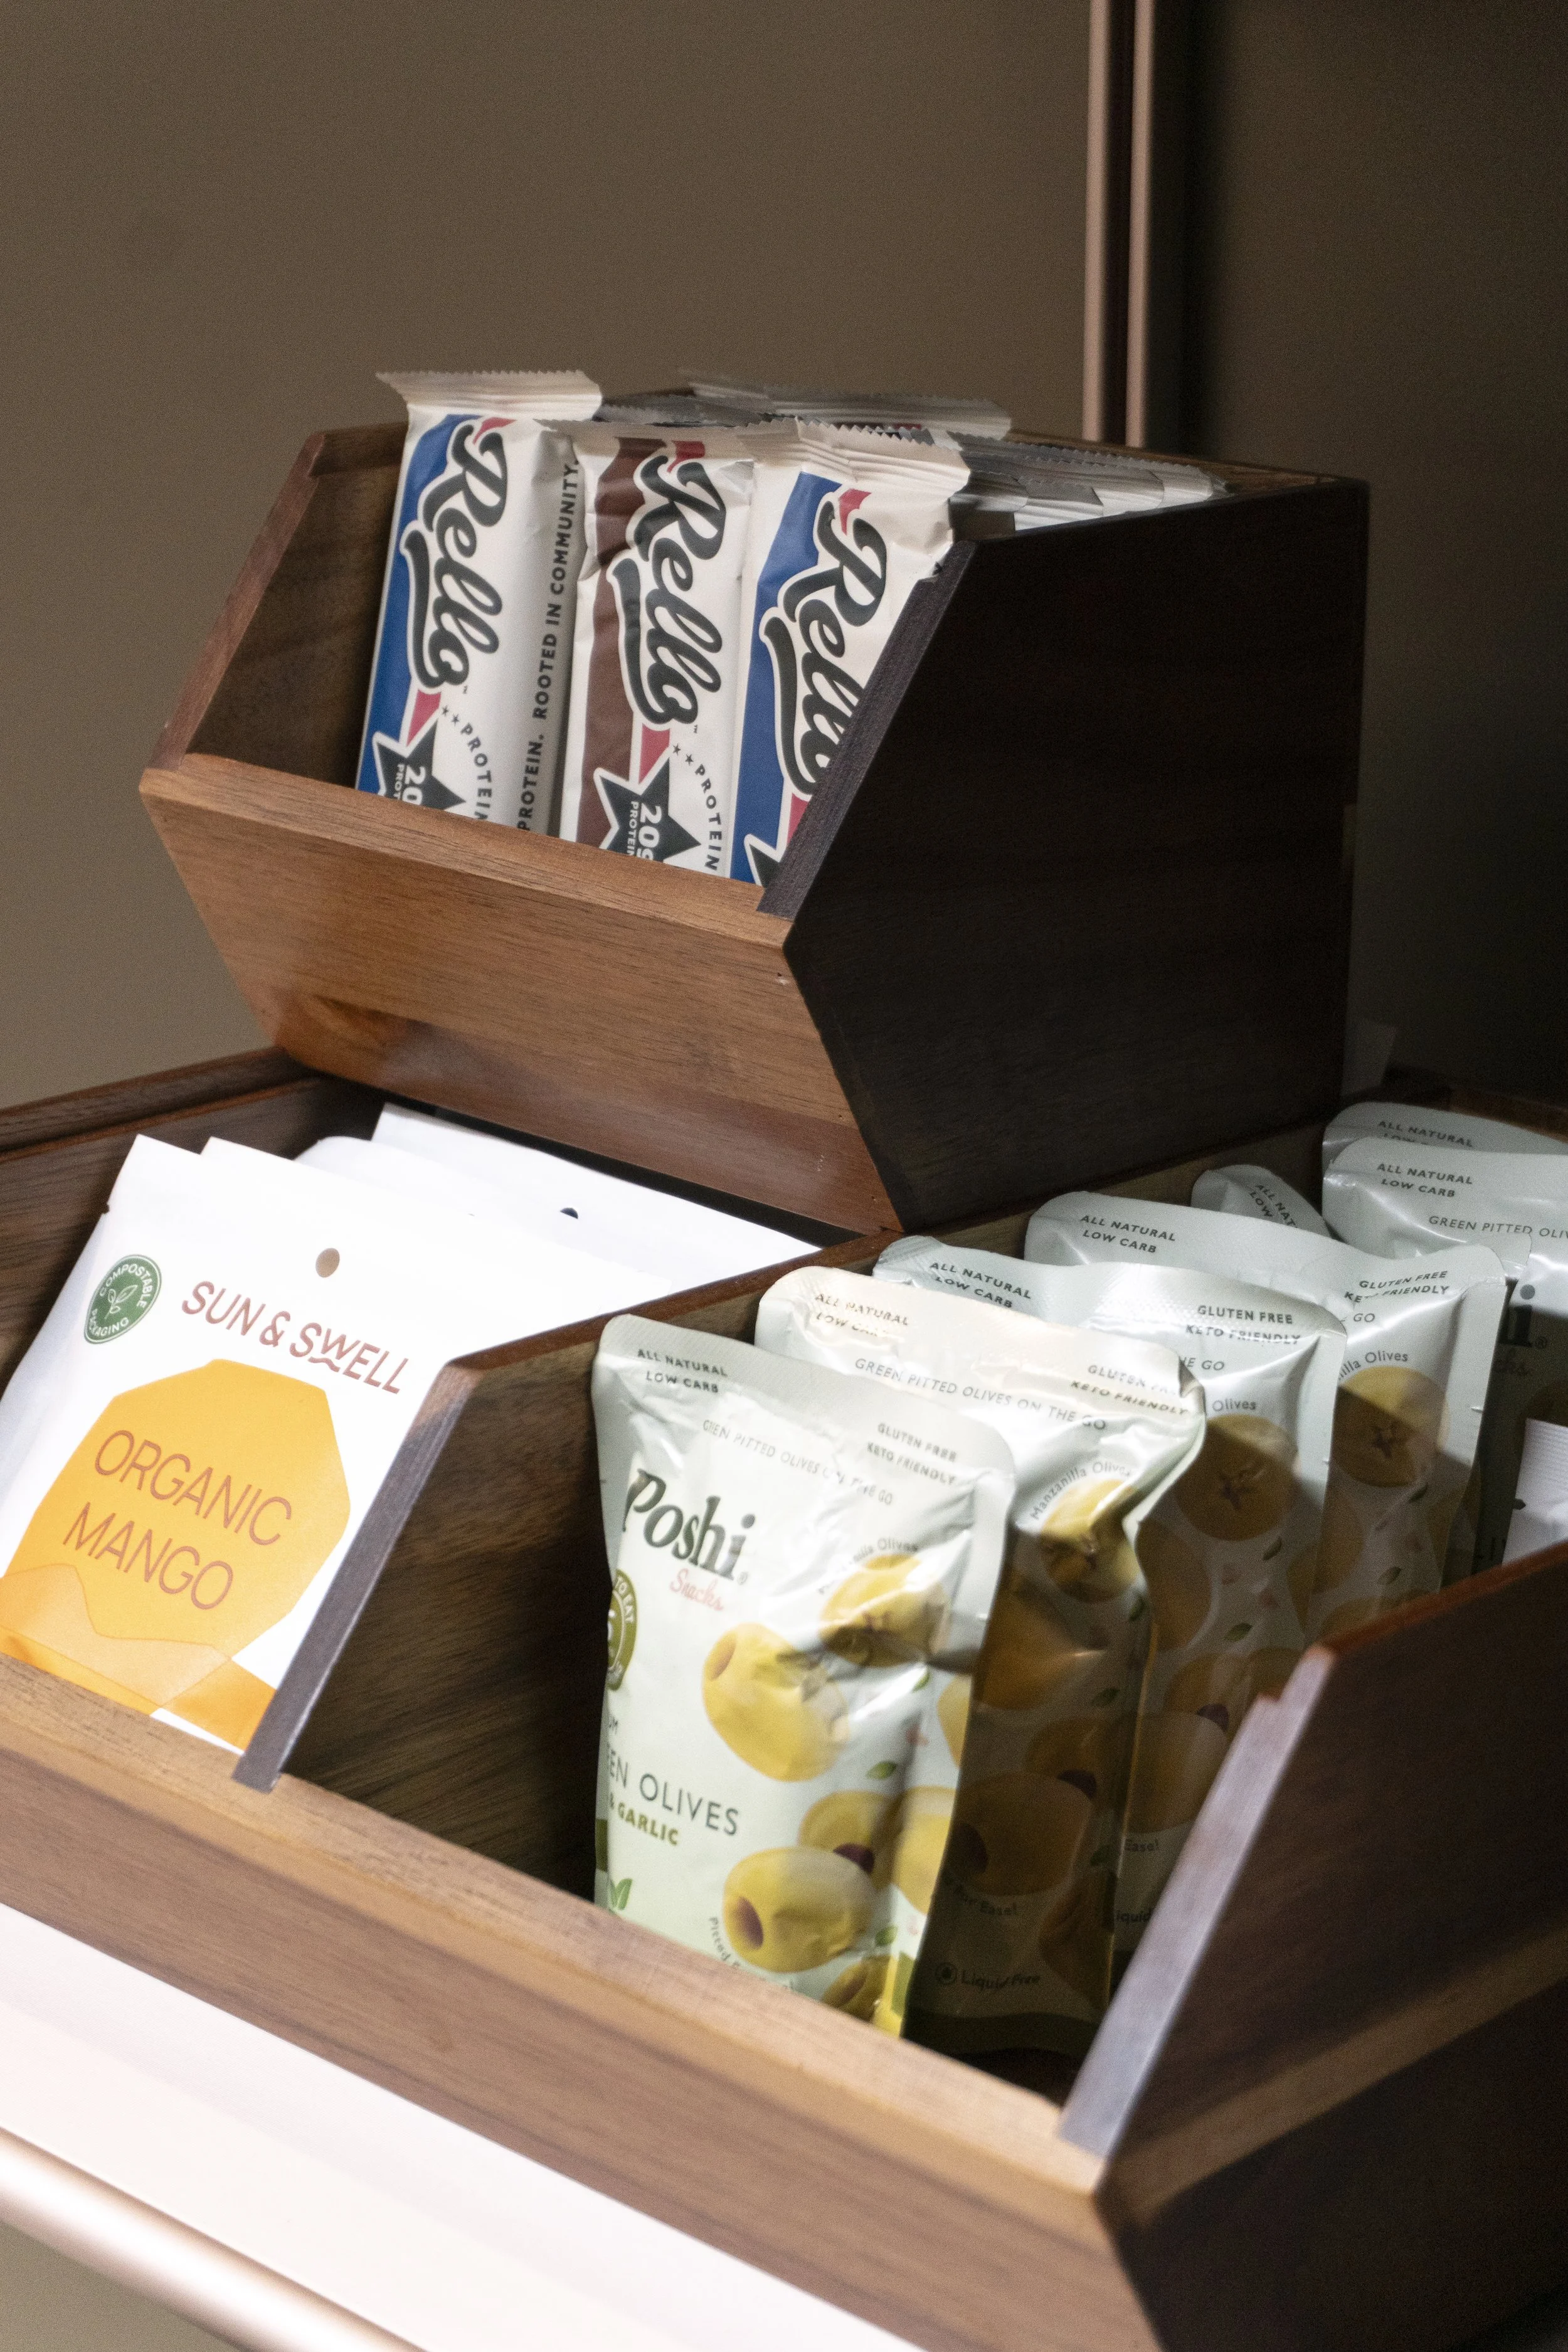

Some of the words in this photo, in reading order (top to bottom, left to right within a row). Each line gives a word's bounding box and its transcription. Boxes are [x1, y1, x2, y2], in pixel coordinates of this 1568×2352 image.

[550, 459, 580, 595] COMMUNITY.
[405, 424, 507, 688] Rello
[612, 455, 727, 725] Rello
[546, 603, 563, 627] IN
[532, 633, 557, 720] ROOTED
[694, 763, 723, 871] PROTEIN
[1379, 1121, 1402, 1131] ALL
[1408, 1127, 1473, 1148] NATURAL
[1377, 1163, 1402, 1175] ALL
[1407, 1168, 1473, 1185] NATURAL
[1382, 1179, 1414, 1190] LOW
[1418, 1185, 1455, 1197] CARB
[1249, 1191, 1273, 1219] LOW
[1255, 1184, 1276, 1200] ALL
[1079, 1215, 1105, 1226] ALL
[1110, 1221, 1176, 1241] NATURAL
[1429, 1216, 1477, 1231] GREEN
[1481, 1222, 1533, 1234] PITTED
[1083, 1229, 1116, 1243] LOW
[1120, 1238, 1157, 1253] CARB
[100, 1263, 153, 1308] COMPOSTABLE
[930, 1262, 956, 1273] ALL
[962, 1268, 1032, 1300] NATURAL
[935, 1276, 970, 1290] LOW
[973, 1288, 1013, 1308] CARB
[1359, 1276, 1412, 1289] GLUTEN
[1415, 1271, 1448, 1281] FREE
[1382, 1285, 1449, 1296] FRIENDLY
[1197, 1305, 1254, 1321] GLUTEN
[1259, 1311, 1293, 1325] FREE
[1353, 1313, 1376, 1323] GO
[182, 1281, 266, 1336] SUN
[259, 1311, 291, 1347] &
[289, 1322, 409, 1395] SWELL
[1185, 1324, 1224, 1337] KETO
[637, 1348, 661, 1362] ALL
[665, 1355, 728, 1377] NATURAL
[1201, 1360, 1225, 1371] GO
[1365, 1350, 1409, 1364] Olives
[646, 1370, 678, 1385] LOW
[682, 1378, 719, 1394] CARB
[1087, 1364, 1146, 1388] GLUTEN
[855, 1357, 903, 1382] GREEN
[907, 1372, 958, 1394] PITTED
[963, 1386, 1012, 1406] OLIVES
[1017, 1399, 1042, 1411] ON
[1048, 1405, 1077, 1422] THE
[1081, 1415, 1107, 1431] GO
[1070, 1380, 1110, 1397] KETO
[1114, 1393, 1189, 1416] FRIENDLY
[1212, 1398, 1257, 1412] Olives
[877, 1421, 923, 1449] GLUTEN
[924, 1443, 958, 1463] FREE
[733, 1432, 776, 1458] PITTED
[780, 1451, 820, 1475] OLIVES
[878, 1489, 893, 1506] GO
[867, 1441, 894, 1462] KETO
[897, 1455, 957, 1485] FRIENDLY
[94, 1429, 293, 1546] ORGANIC
[1030, 1466, 1088, 1521] Manzanilla
[63, 1502, 234, 1611] MANGO
[670, 1567, 725, 1612] Snacks
[639, 1773, 739, 1836] OLIVES
[617, 1801, 679, 1846] GARLIC
